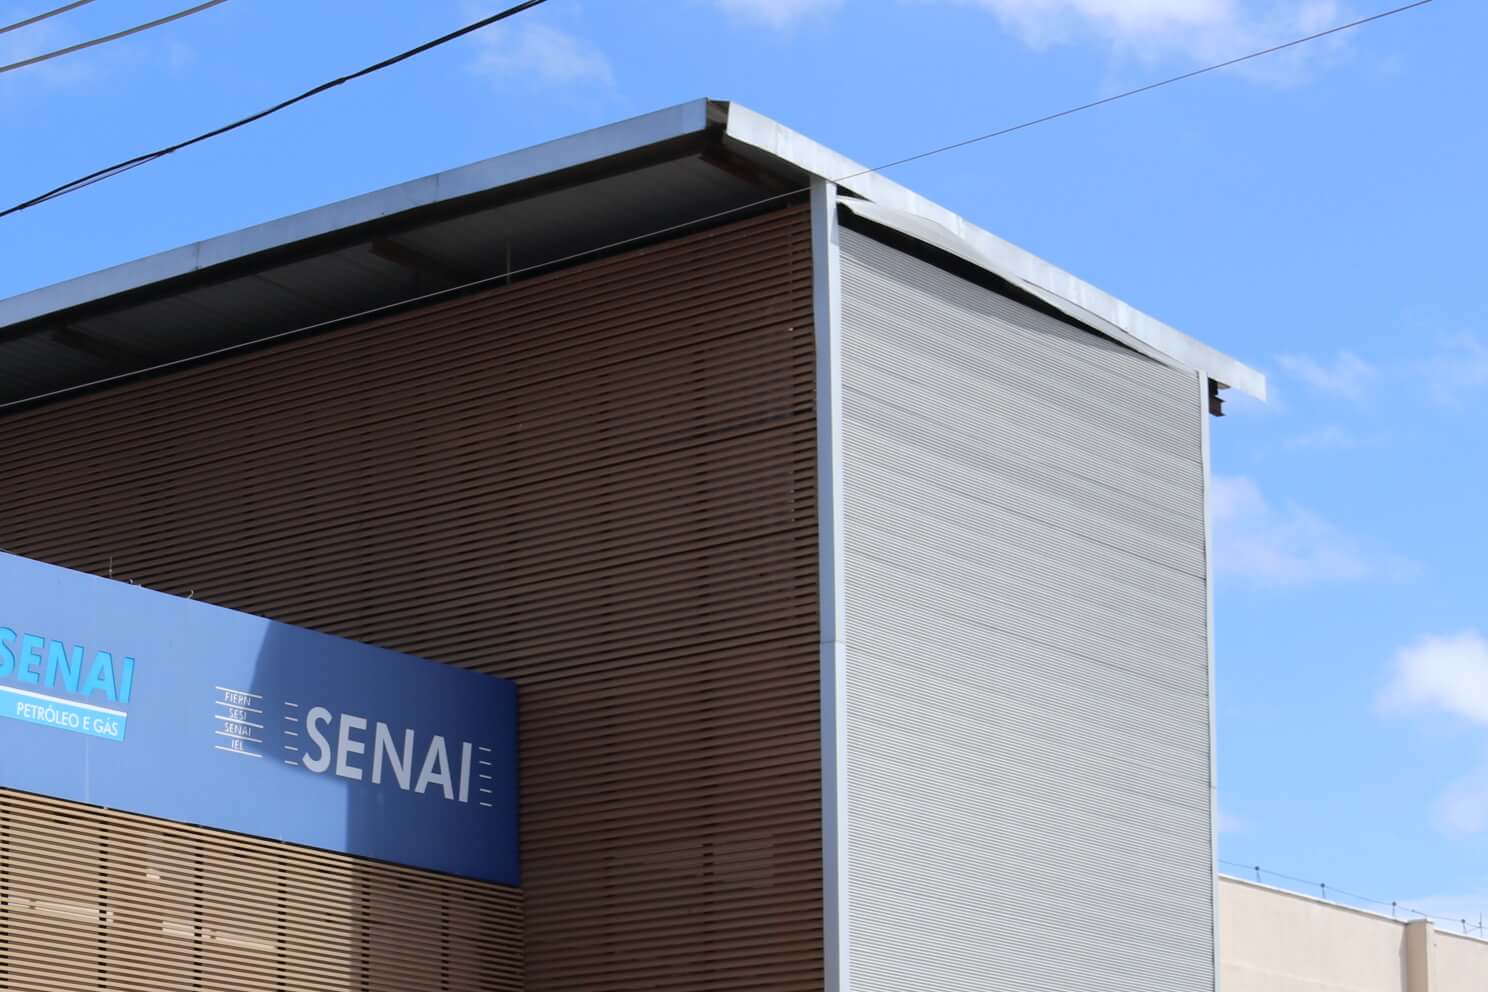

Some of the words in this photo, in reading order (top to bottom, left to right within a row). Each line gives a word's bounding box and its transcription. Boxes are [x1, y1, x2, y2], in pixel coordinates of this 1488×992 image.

[16, 700, 80, 728] PETRÓLEO
[82, 715, 91, 730] E
[92, 714, 120, 737] GÁS
[224, 721, 252, 737] SENAI
[301, 706, 473, 803] SENAI
